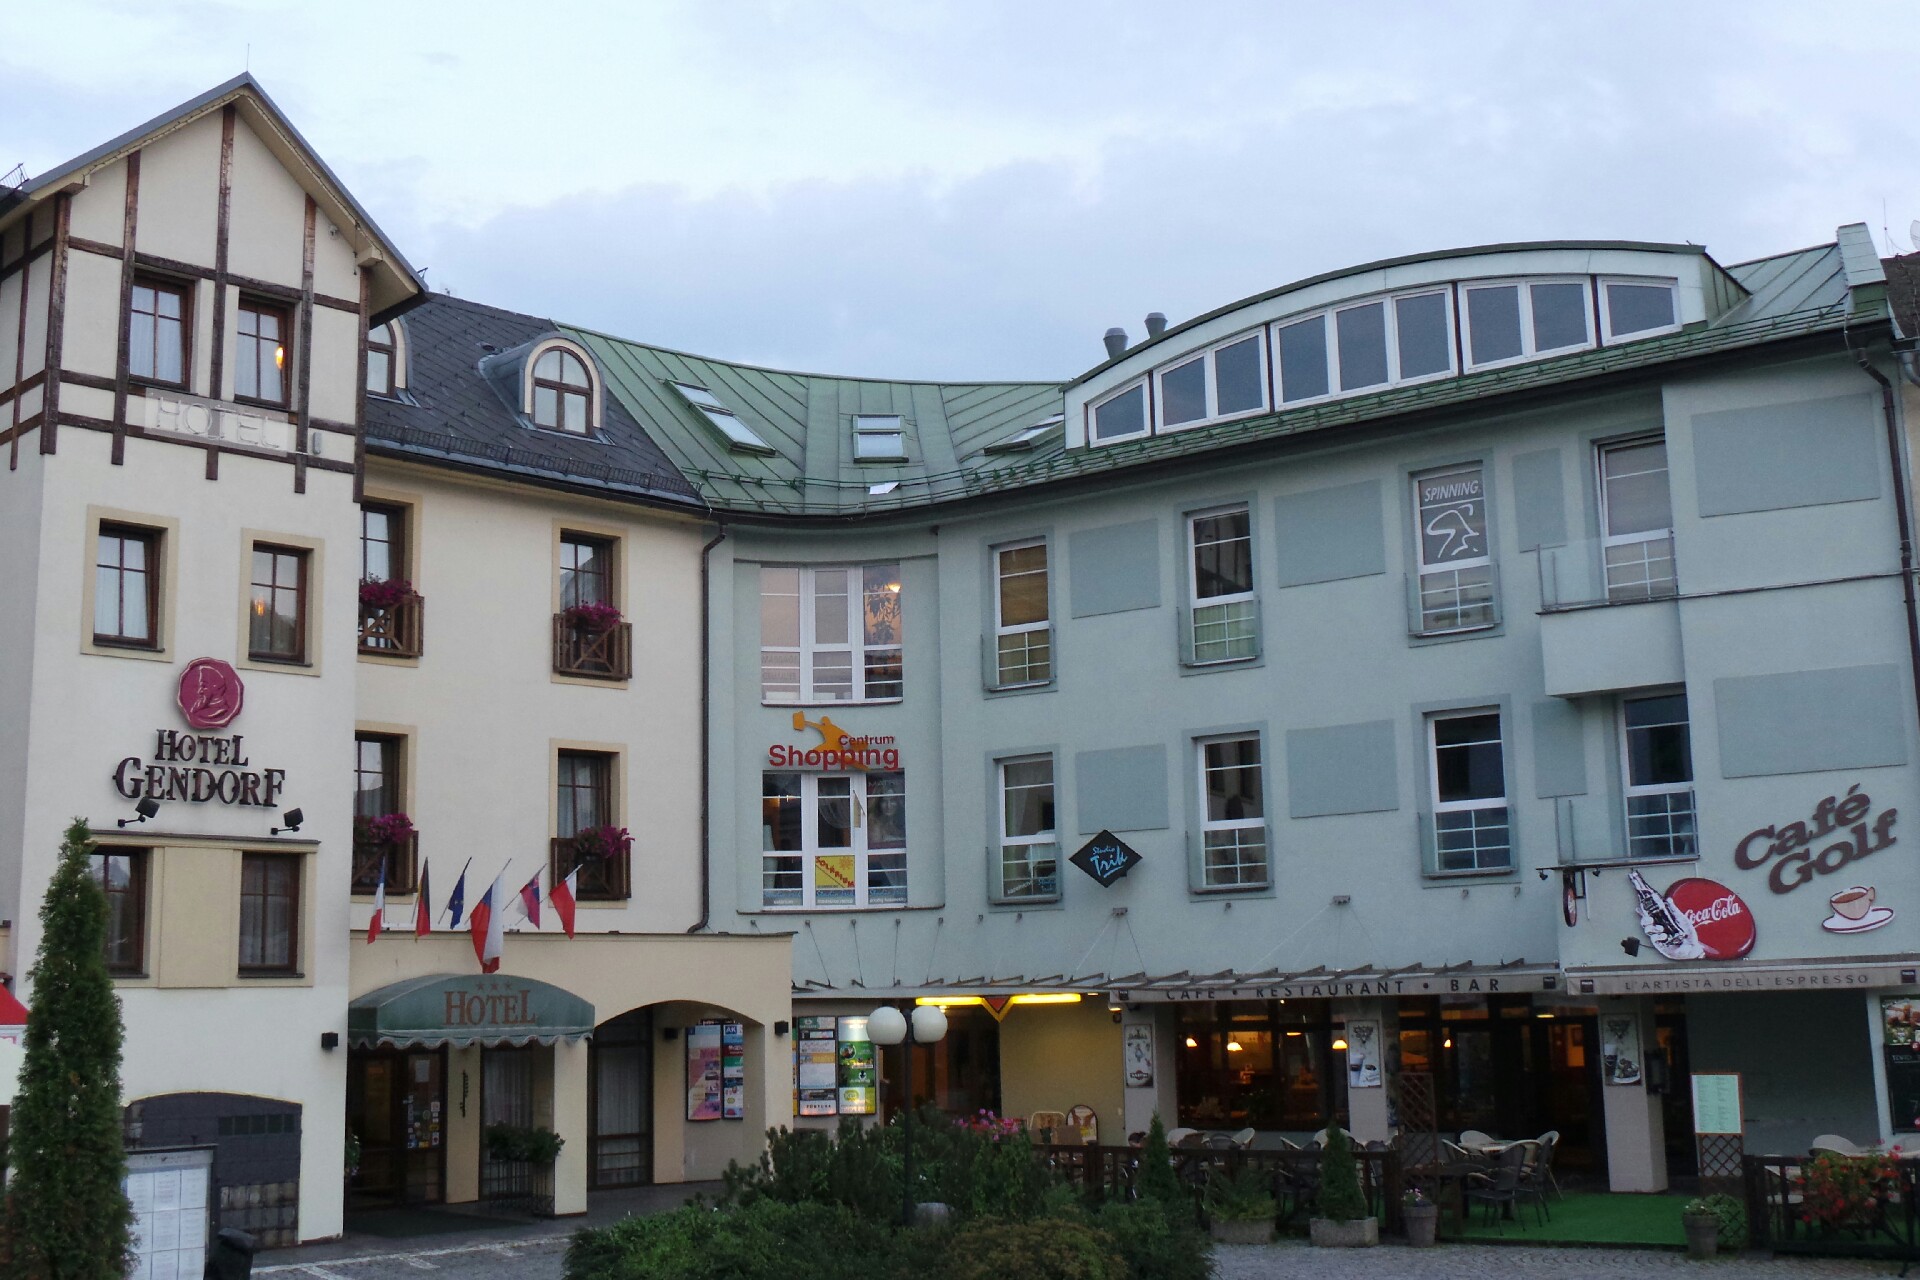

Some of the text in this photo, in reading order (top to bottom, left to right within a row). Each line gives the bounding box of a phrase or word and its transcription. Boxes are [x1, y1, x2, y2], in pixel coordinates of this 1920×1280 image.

[156, 396, 280, 448] HOTEL
[1424, 480, 1479, 501] SPINNING
[155, 729, 249, 766] HOTEL
[839, 735, 895, 746] Centrum
[768, 744, 899, 771] Shopping
[112, 757, 286, 807] GENDORF
[1734, 783, 1871, 870] Café
[1090, 846, 1129, 877] Trik
[1091, 845, 1116, 855] Studio
[1768, 808, 1898, 894] Golf
[1685, 895, 1741, 928] Coca-Cola
[1451, 979, 1499, 991] BAR
[1625, 975, 1869, 990] L'ARTISTA DELL'ESPRESSO
[443, 990, 537, 1025] HOTEL
